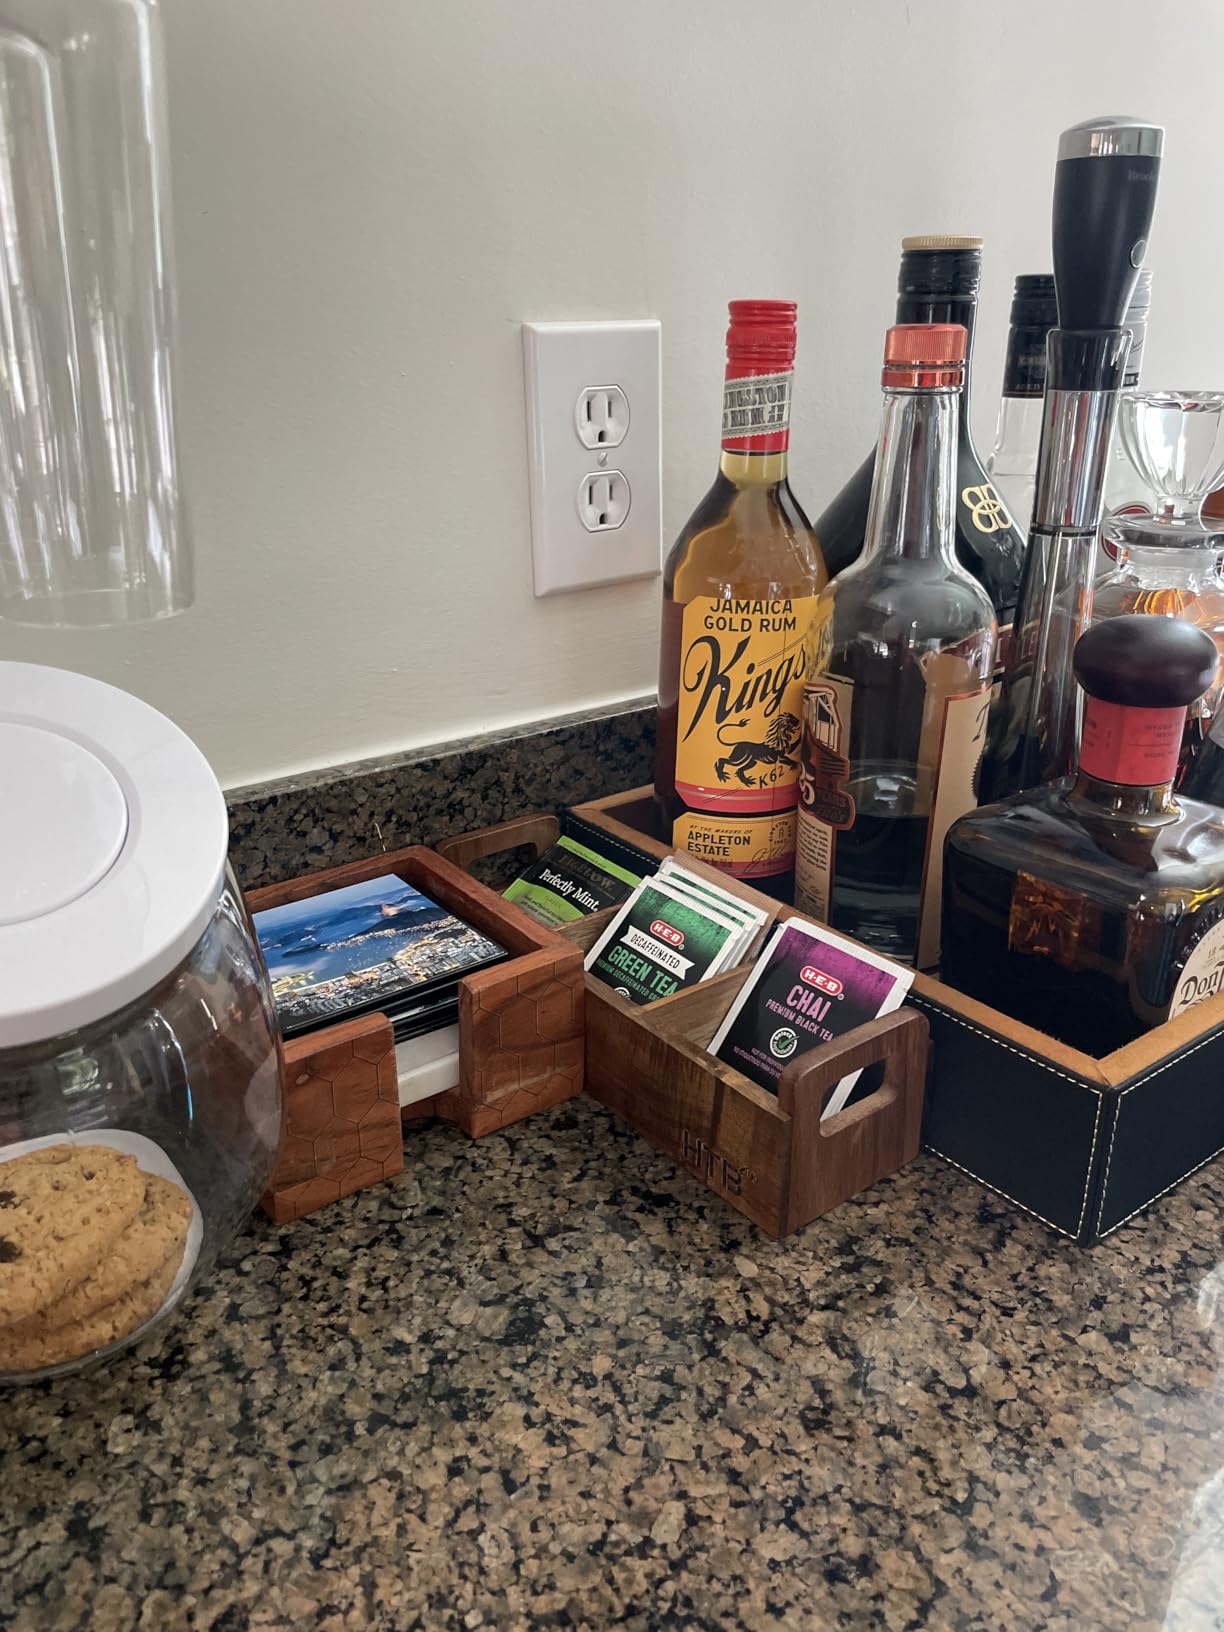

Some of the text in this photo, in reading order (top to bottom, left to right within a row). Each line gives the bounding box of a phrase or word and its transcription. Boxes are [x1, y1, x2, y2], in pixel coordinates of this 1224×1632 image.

[704, 615, 797, 632] GOLD RUM
[709, 599, 793, 615] JAMAICA
[682, 635, 806, 743] Kings
[687, 831, 751, 846] APPLETON
[687, 841, 730, 857] ESTATE
[539, 868, 576, 896] Perfectly
[630, 933, 680, 969] DECAFFEINATED
[608, 945, 678, 997] GREEN TEA
[1179, 970, 1219, 1005] Don
[765, 999, 834, 1041] PREMIUM BLACK TEA
[786, 985, 831, 1022] CHAI
